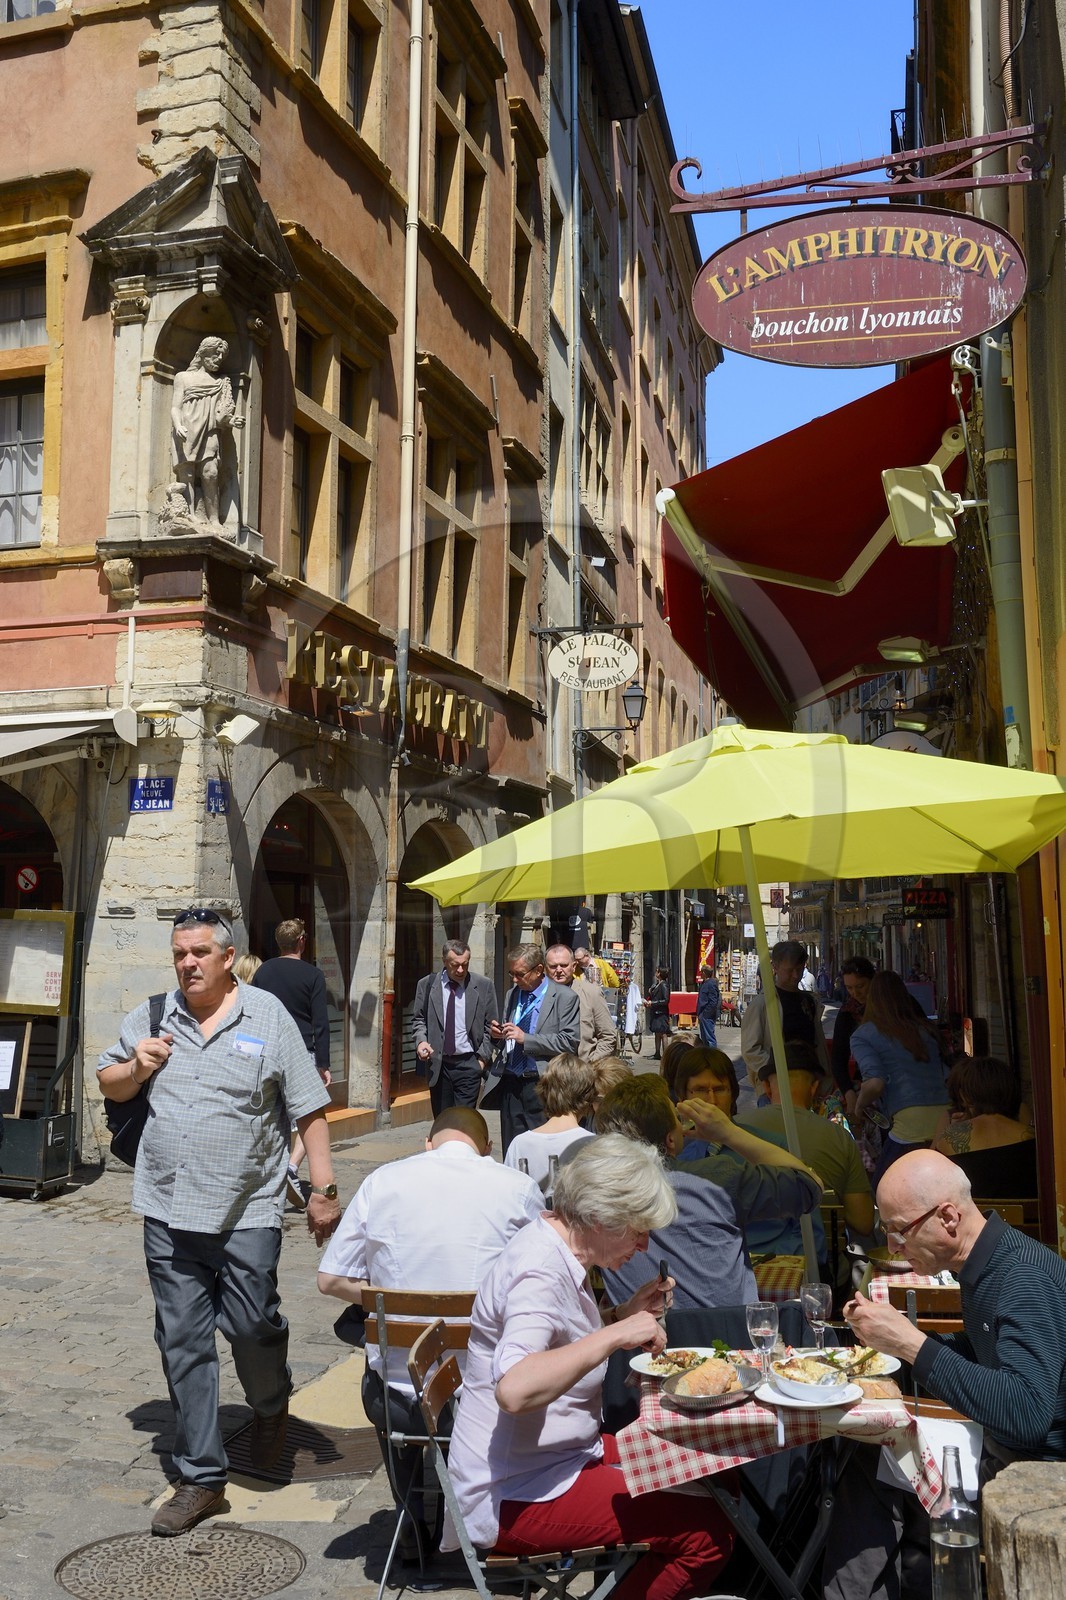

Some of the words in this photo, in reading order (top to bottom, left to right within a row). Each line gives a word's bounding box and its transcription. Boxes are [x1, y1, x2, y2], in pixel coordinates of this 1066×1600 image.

[705, 225, 1012, 303] L'AMPHITRYON
[751, 310, 849, 339] bouchon
[859, 301, 963, 334] lyonnais
[559, 638, 577, 656] LE
[584, 634, 631, 657] PALAIS
[568, 655, 581, 669] St
[585, 656, 621, 669] JEAN
[559, 668, 627, 689] RESTAURANT
[138, 779, 166, 790] PLACE
[141, 789, 163, 798] NEUVE
[145, 798, 170, 809] JEAN
[906, 891, 947, 905] PIZZA
